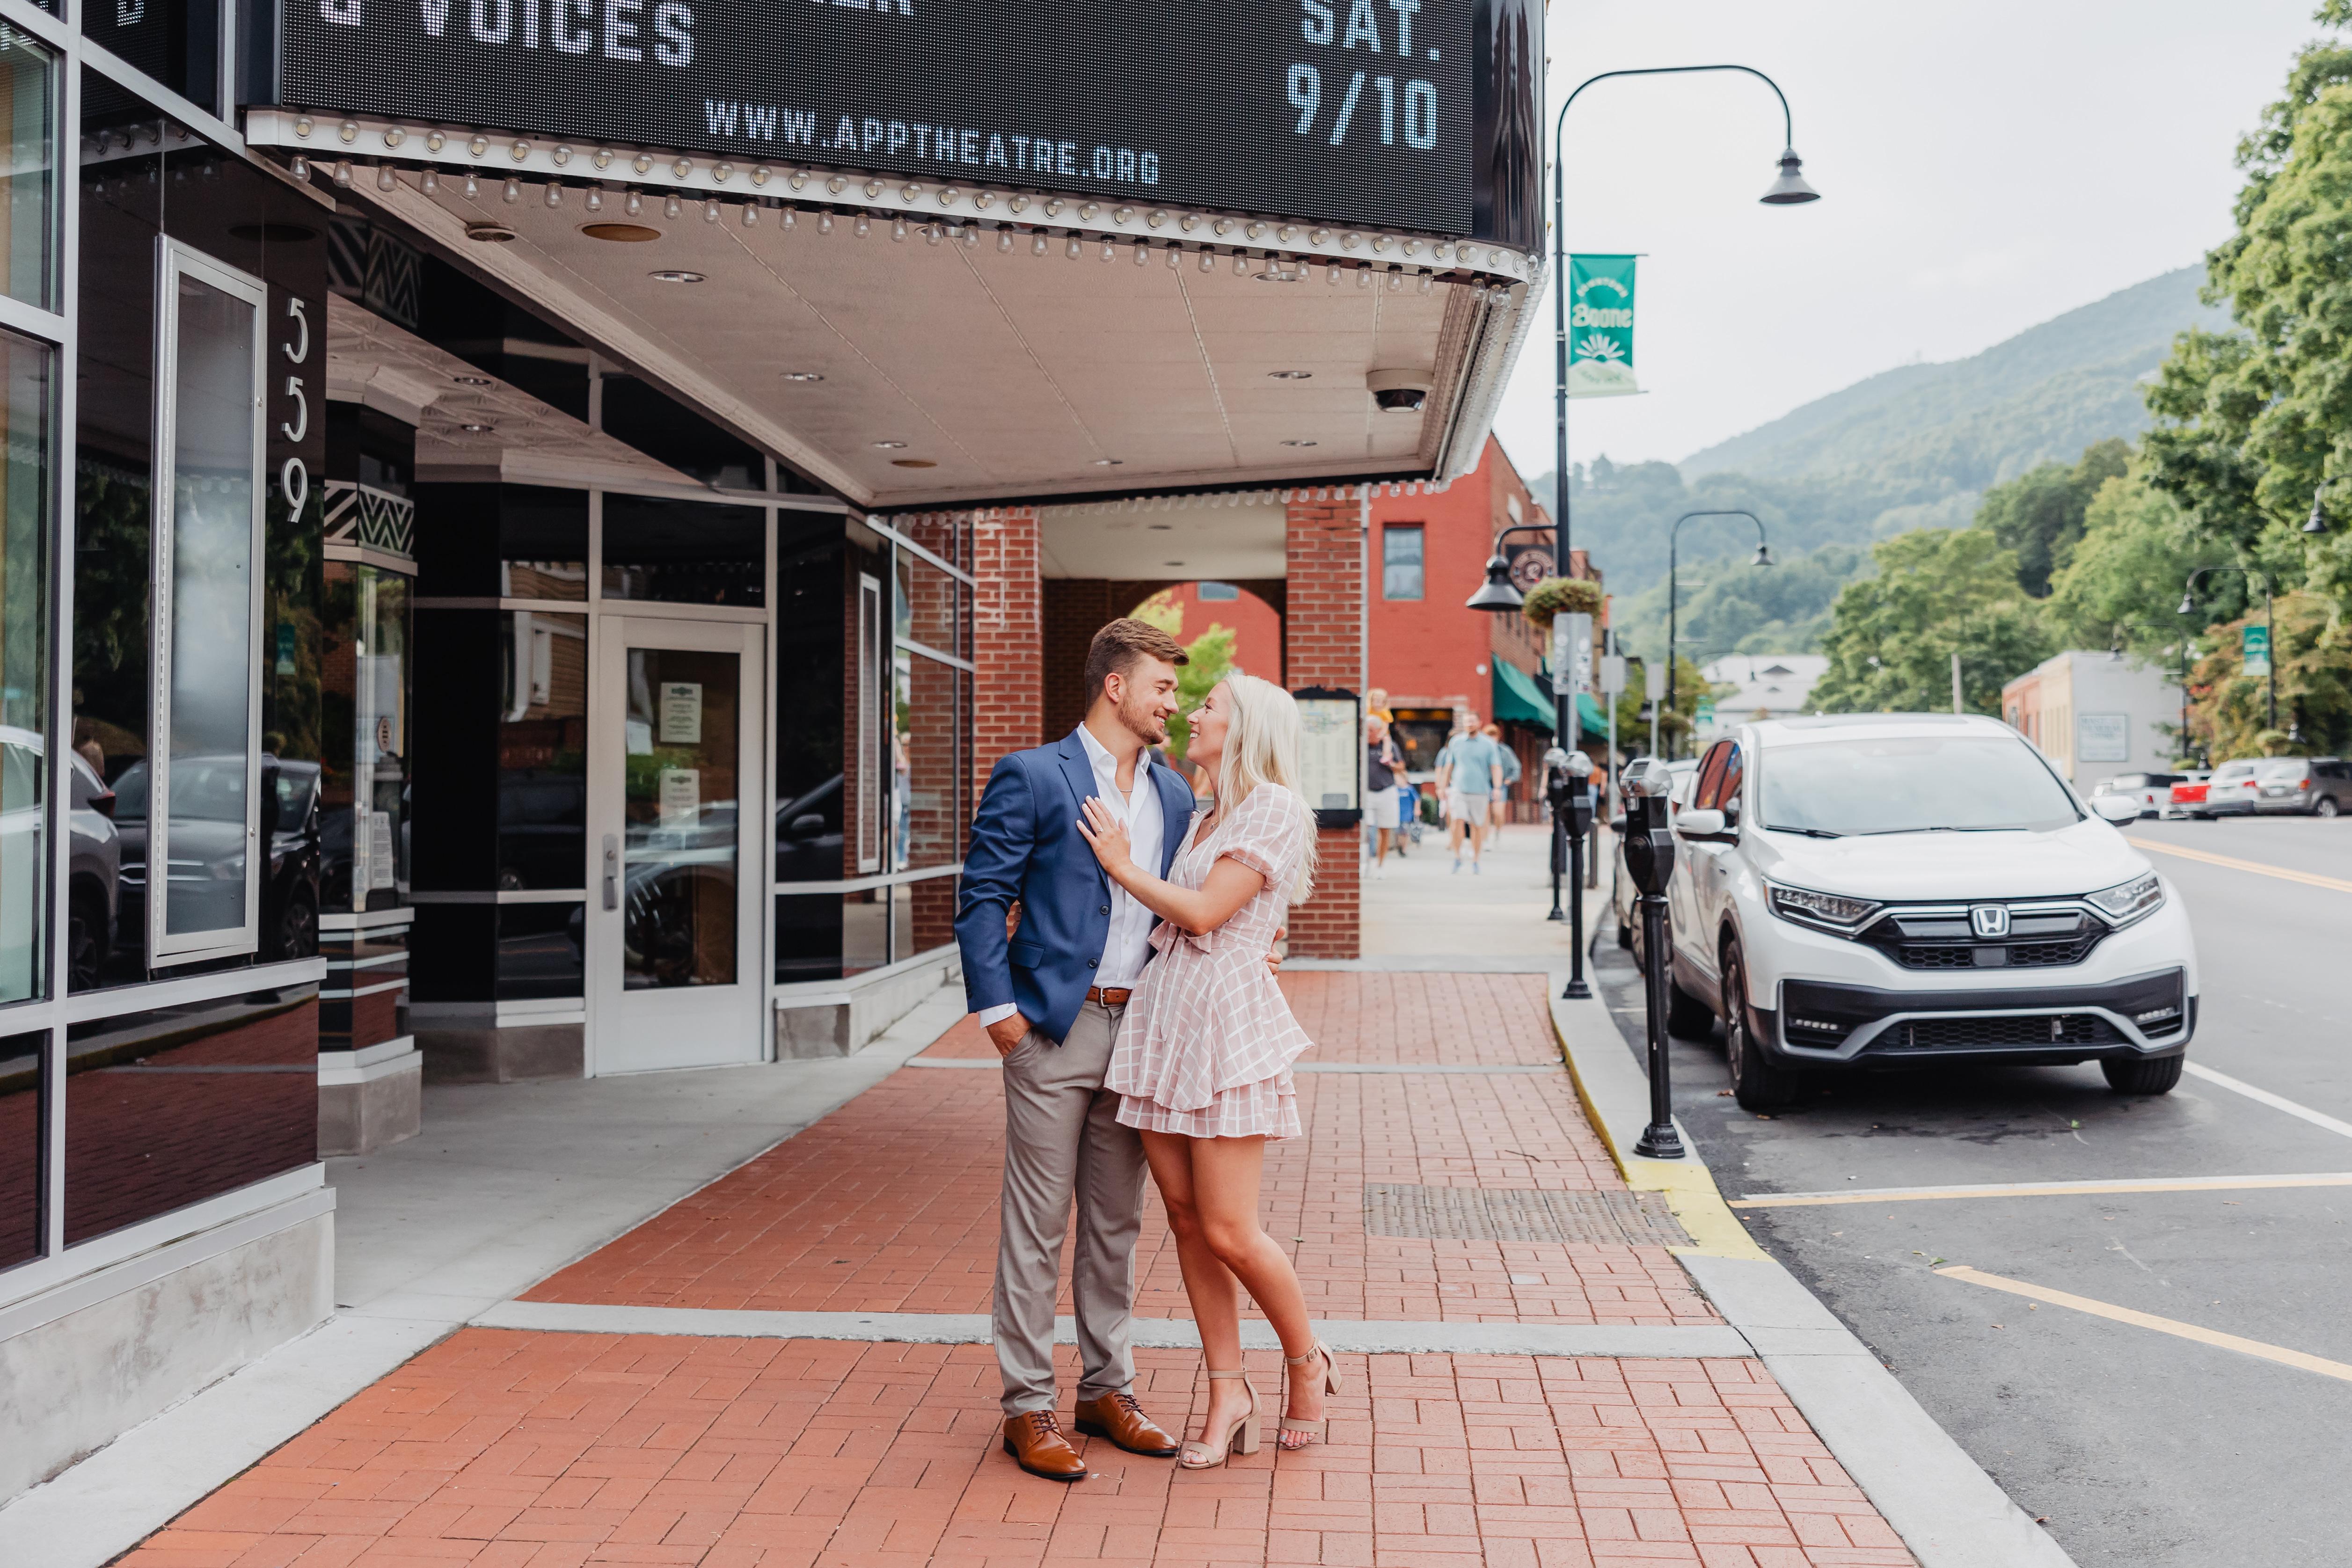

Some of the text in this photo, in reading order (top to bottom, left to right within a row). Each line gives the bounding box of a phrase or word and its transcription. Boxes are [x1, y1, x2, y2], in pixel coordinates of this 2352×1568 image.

[422, 0, 695, 67] VOICES
[1301, 0, 1439, 60] SAT.
[1288, 63, 1437, 150] 9/10
[705, 98, 1158, 184] WWW.APPTHEATRE.ORG
[1572, 302, 1632, 328] Boone
